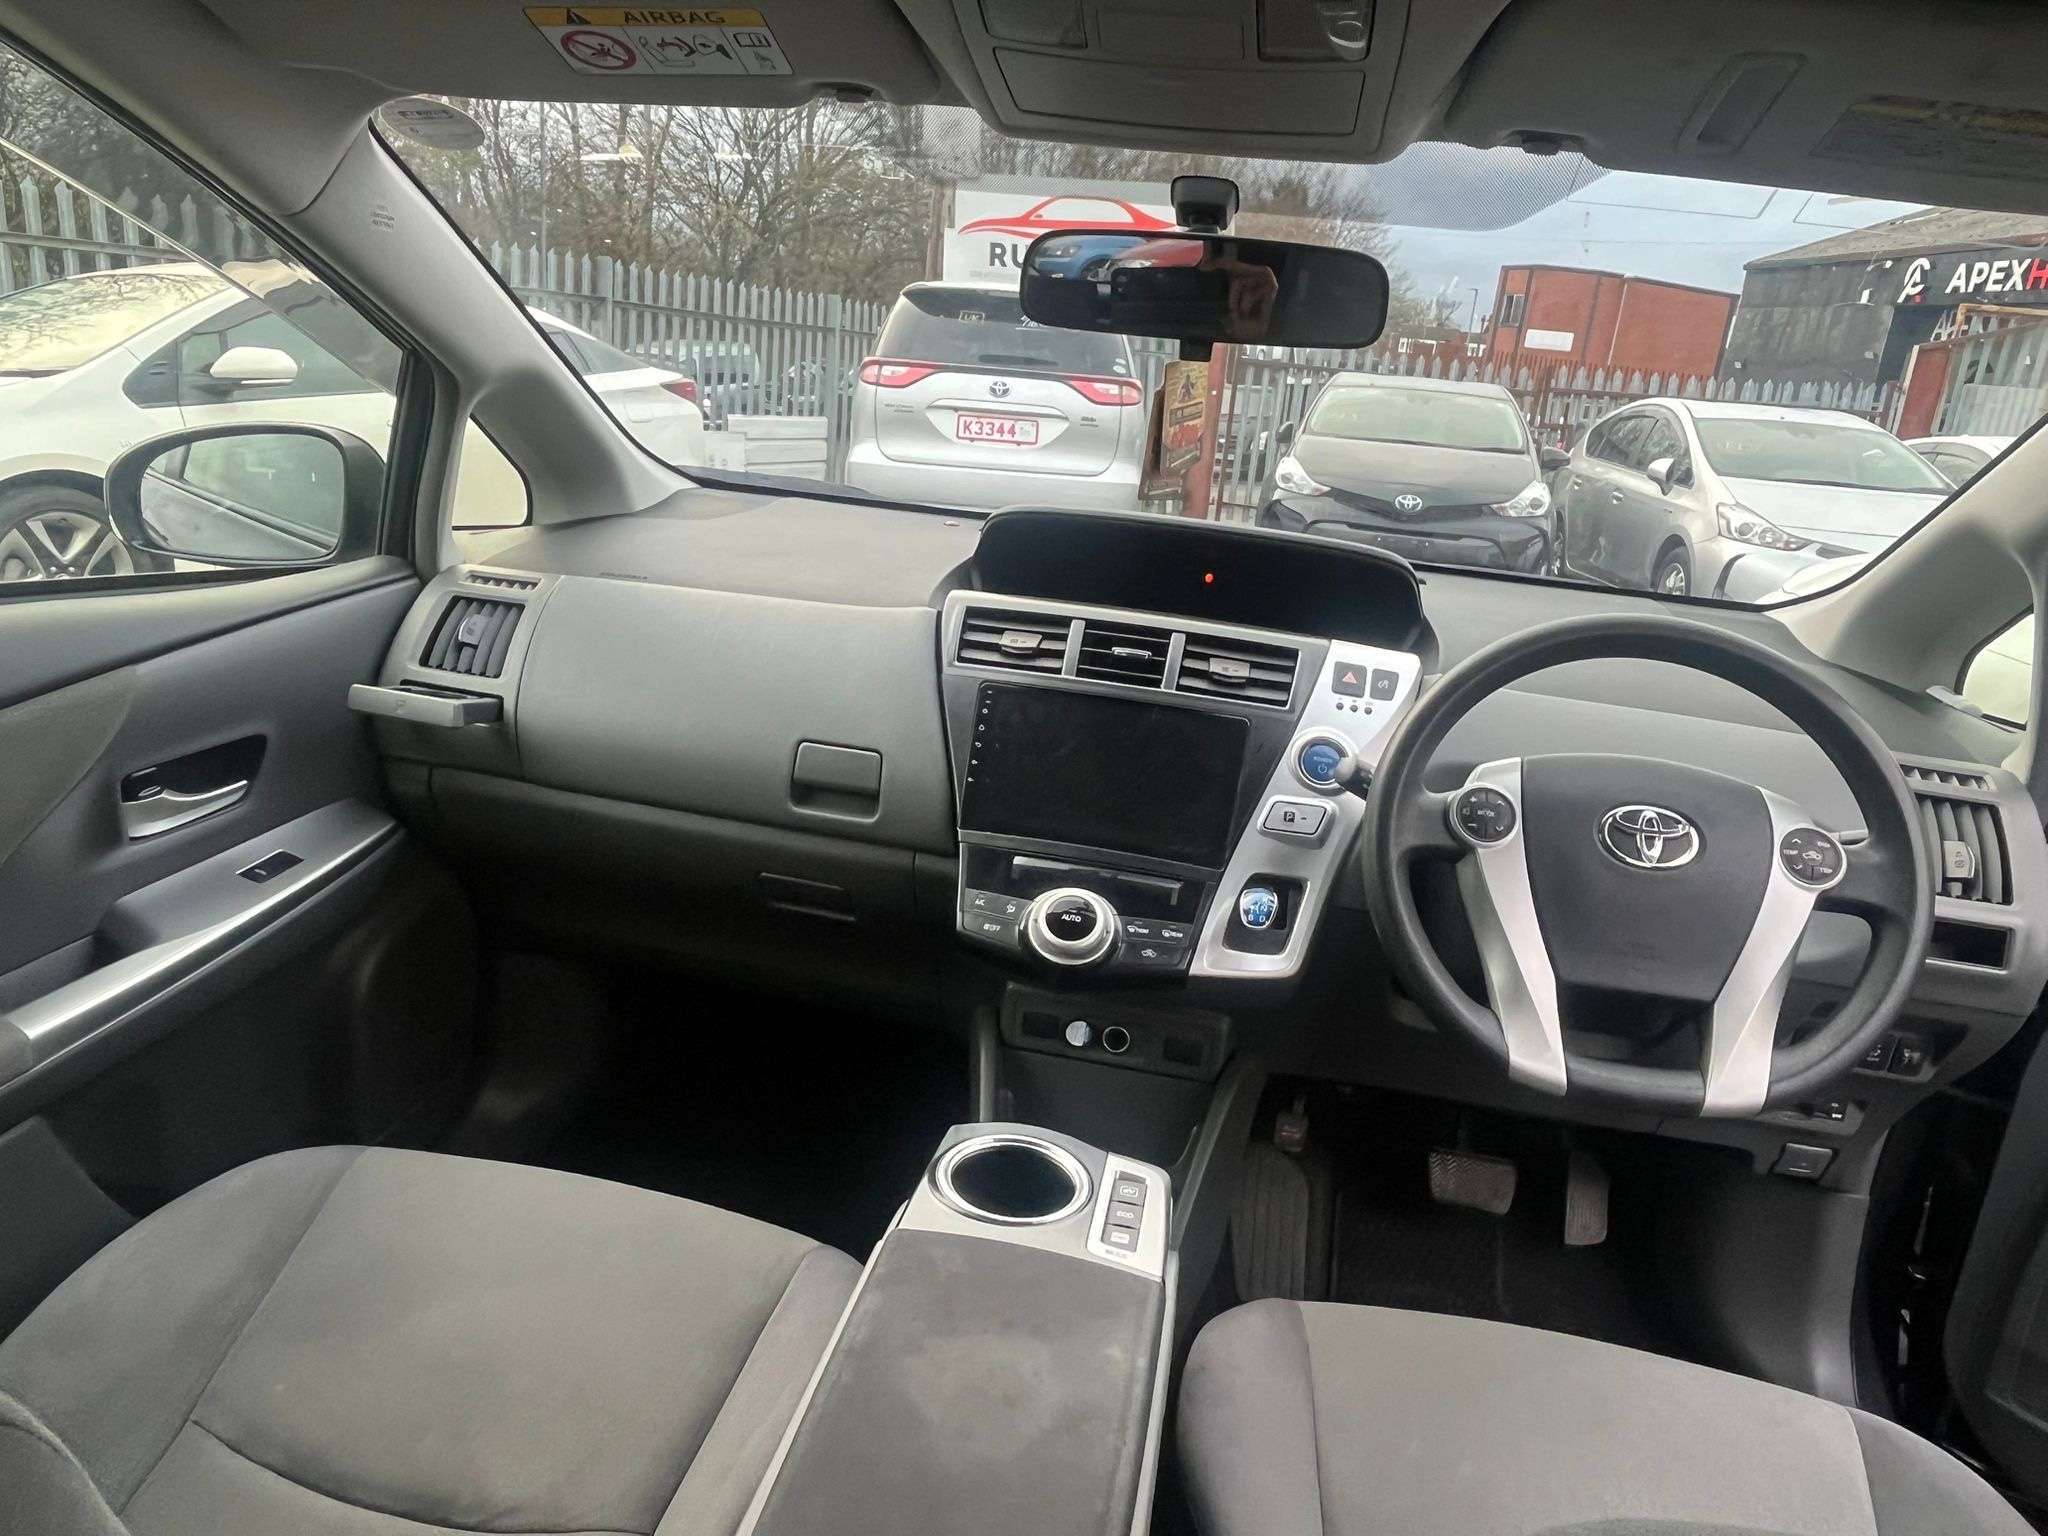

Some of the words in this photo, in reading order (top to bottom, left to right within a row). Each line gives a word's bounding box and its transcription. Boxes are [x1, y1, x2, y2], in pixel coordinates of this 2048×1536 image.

[624, 10, 726, 25] AIRBAG
[963, 420, 1016, 438] K3344
[1061, 913, 1082, 922] AUTO
